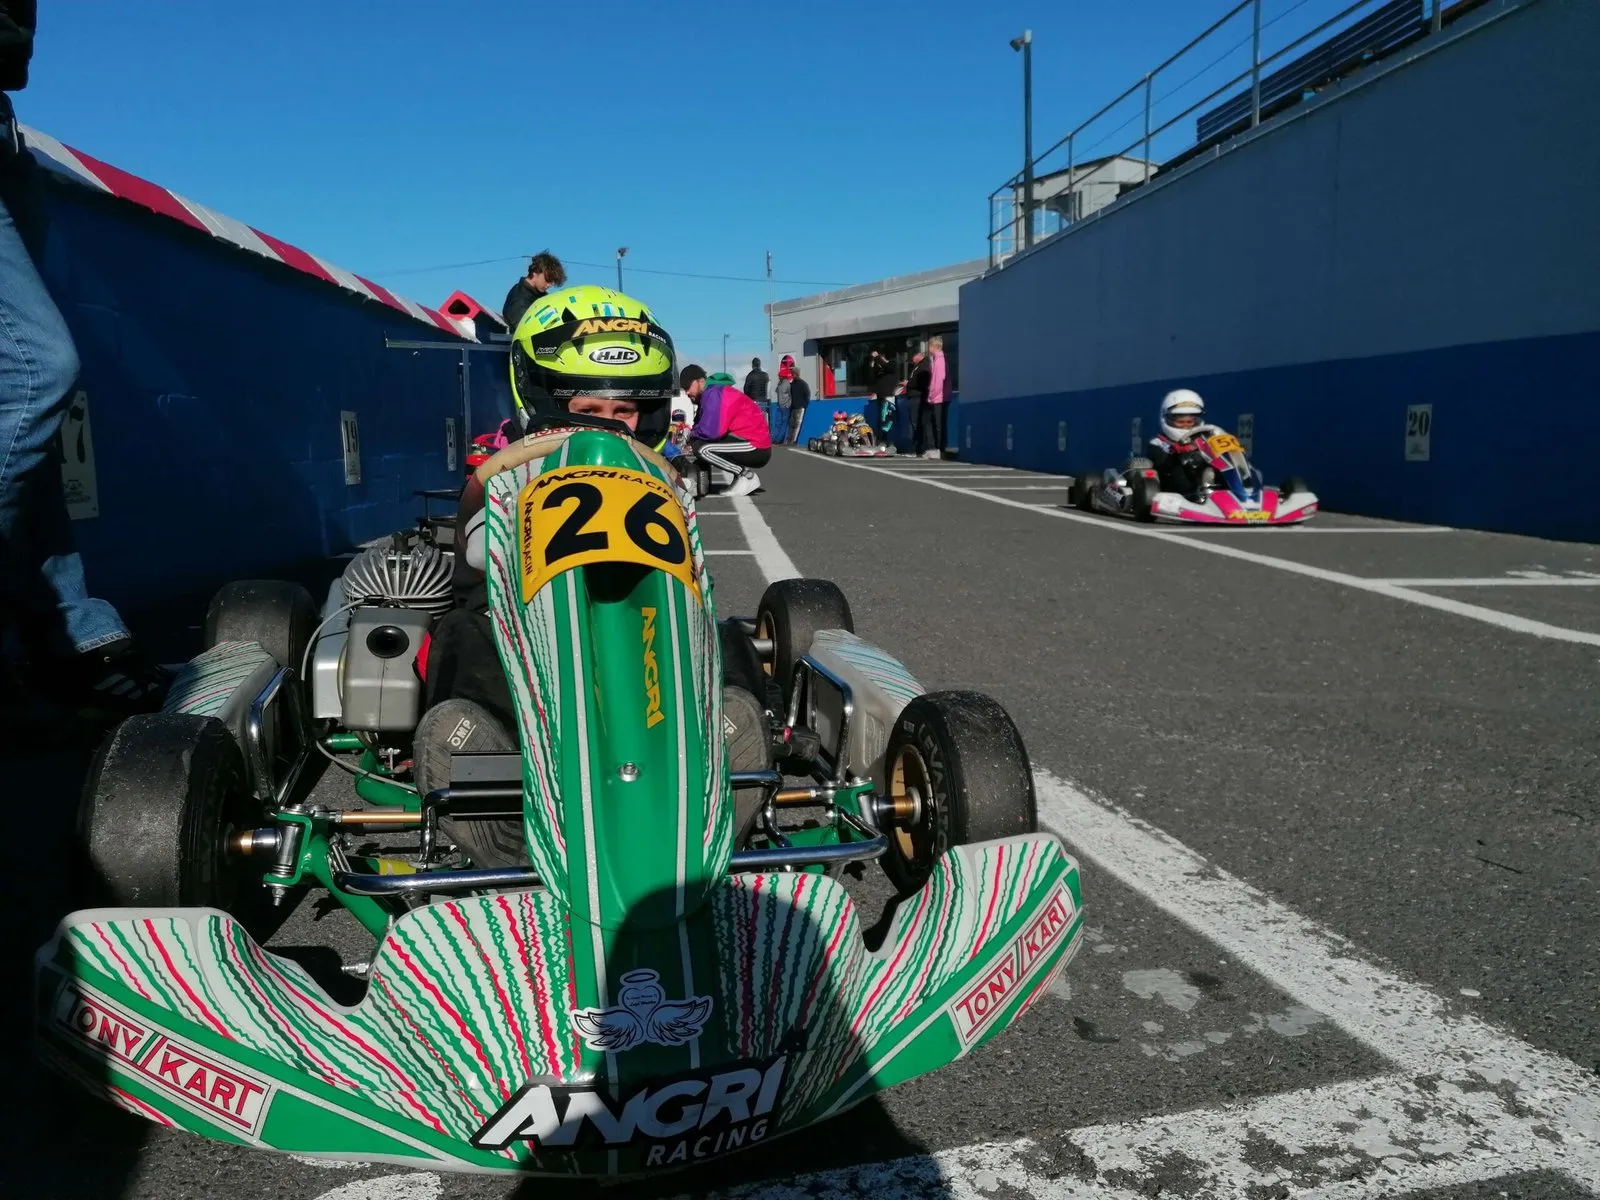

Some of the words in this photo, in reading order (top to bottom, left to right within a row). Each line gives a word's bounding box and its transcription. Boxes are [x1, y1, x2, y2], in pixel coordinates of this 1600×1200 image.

[572, 319, 648, 338] ANGRI
[596, 350, 635, 362] HJC
[344, 420, 359, 453] 19
[1408, 411, 1430, 437] 20
[529, 470, 618, 498] ANGRI
[523, 501, 534, 544] ANGRI
[541, 482, 686, 565] 26
[641, 607, 665, 729] ANGRI
[450, 719, 472, 747] OMP
[955, 951, 1015, 1026] TONY
[1023, 887, 1068, 962] KART
[67, 985, 145, 1056] TONY
[158, 1043, 265, 1116] KART
[478, 1055, 787, 1146] ANGRI
[646, 1117, 769, 1167] RACING
